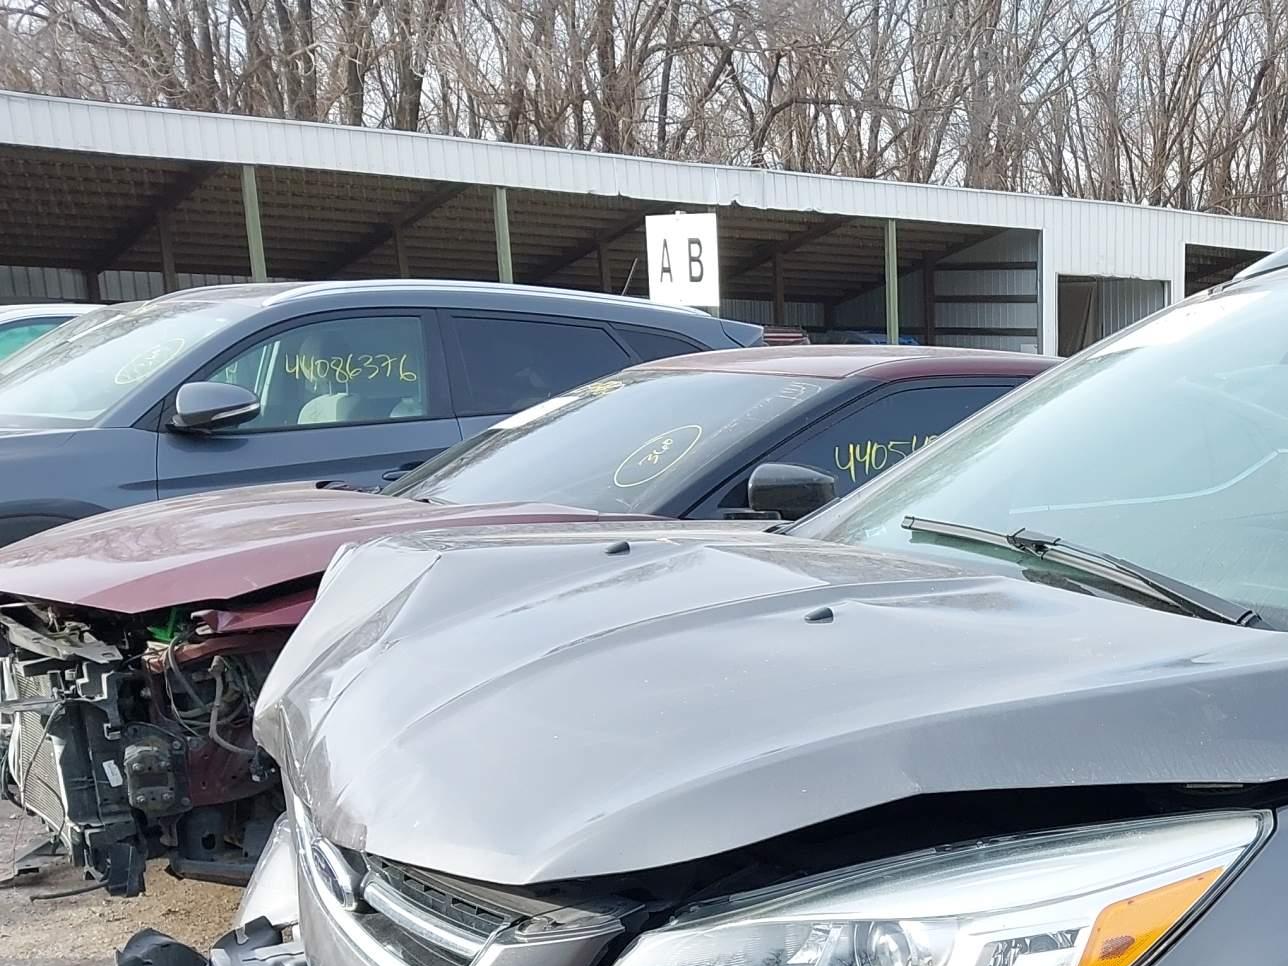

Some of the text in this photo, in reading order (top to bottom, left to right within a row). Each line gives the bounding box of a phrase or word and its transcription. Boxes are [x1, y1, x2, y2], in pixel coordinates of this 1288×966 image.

[660, 237, 704, 283] A B
[285, 352, 418, 383] 44086376
